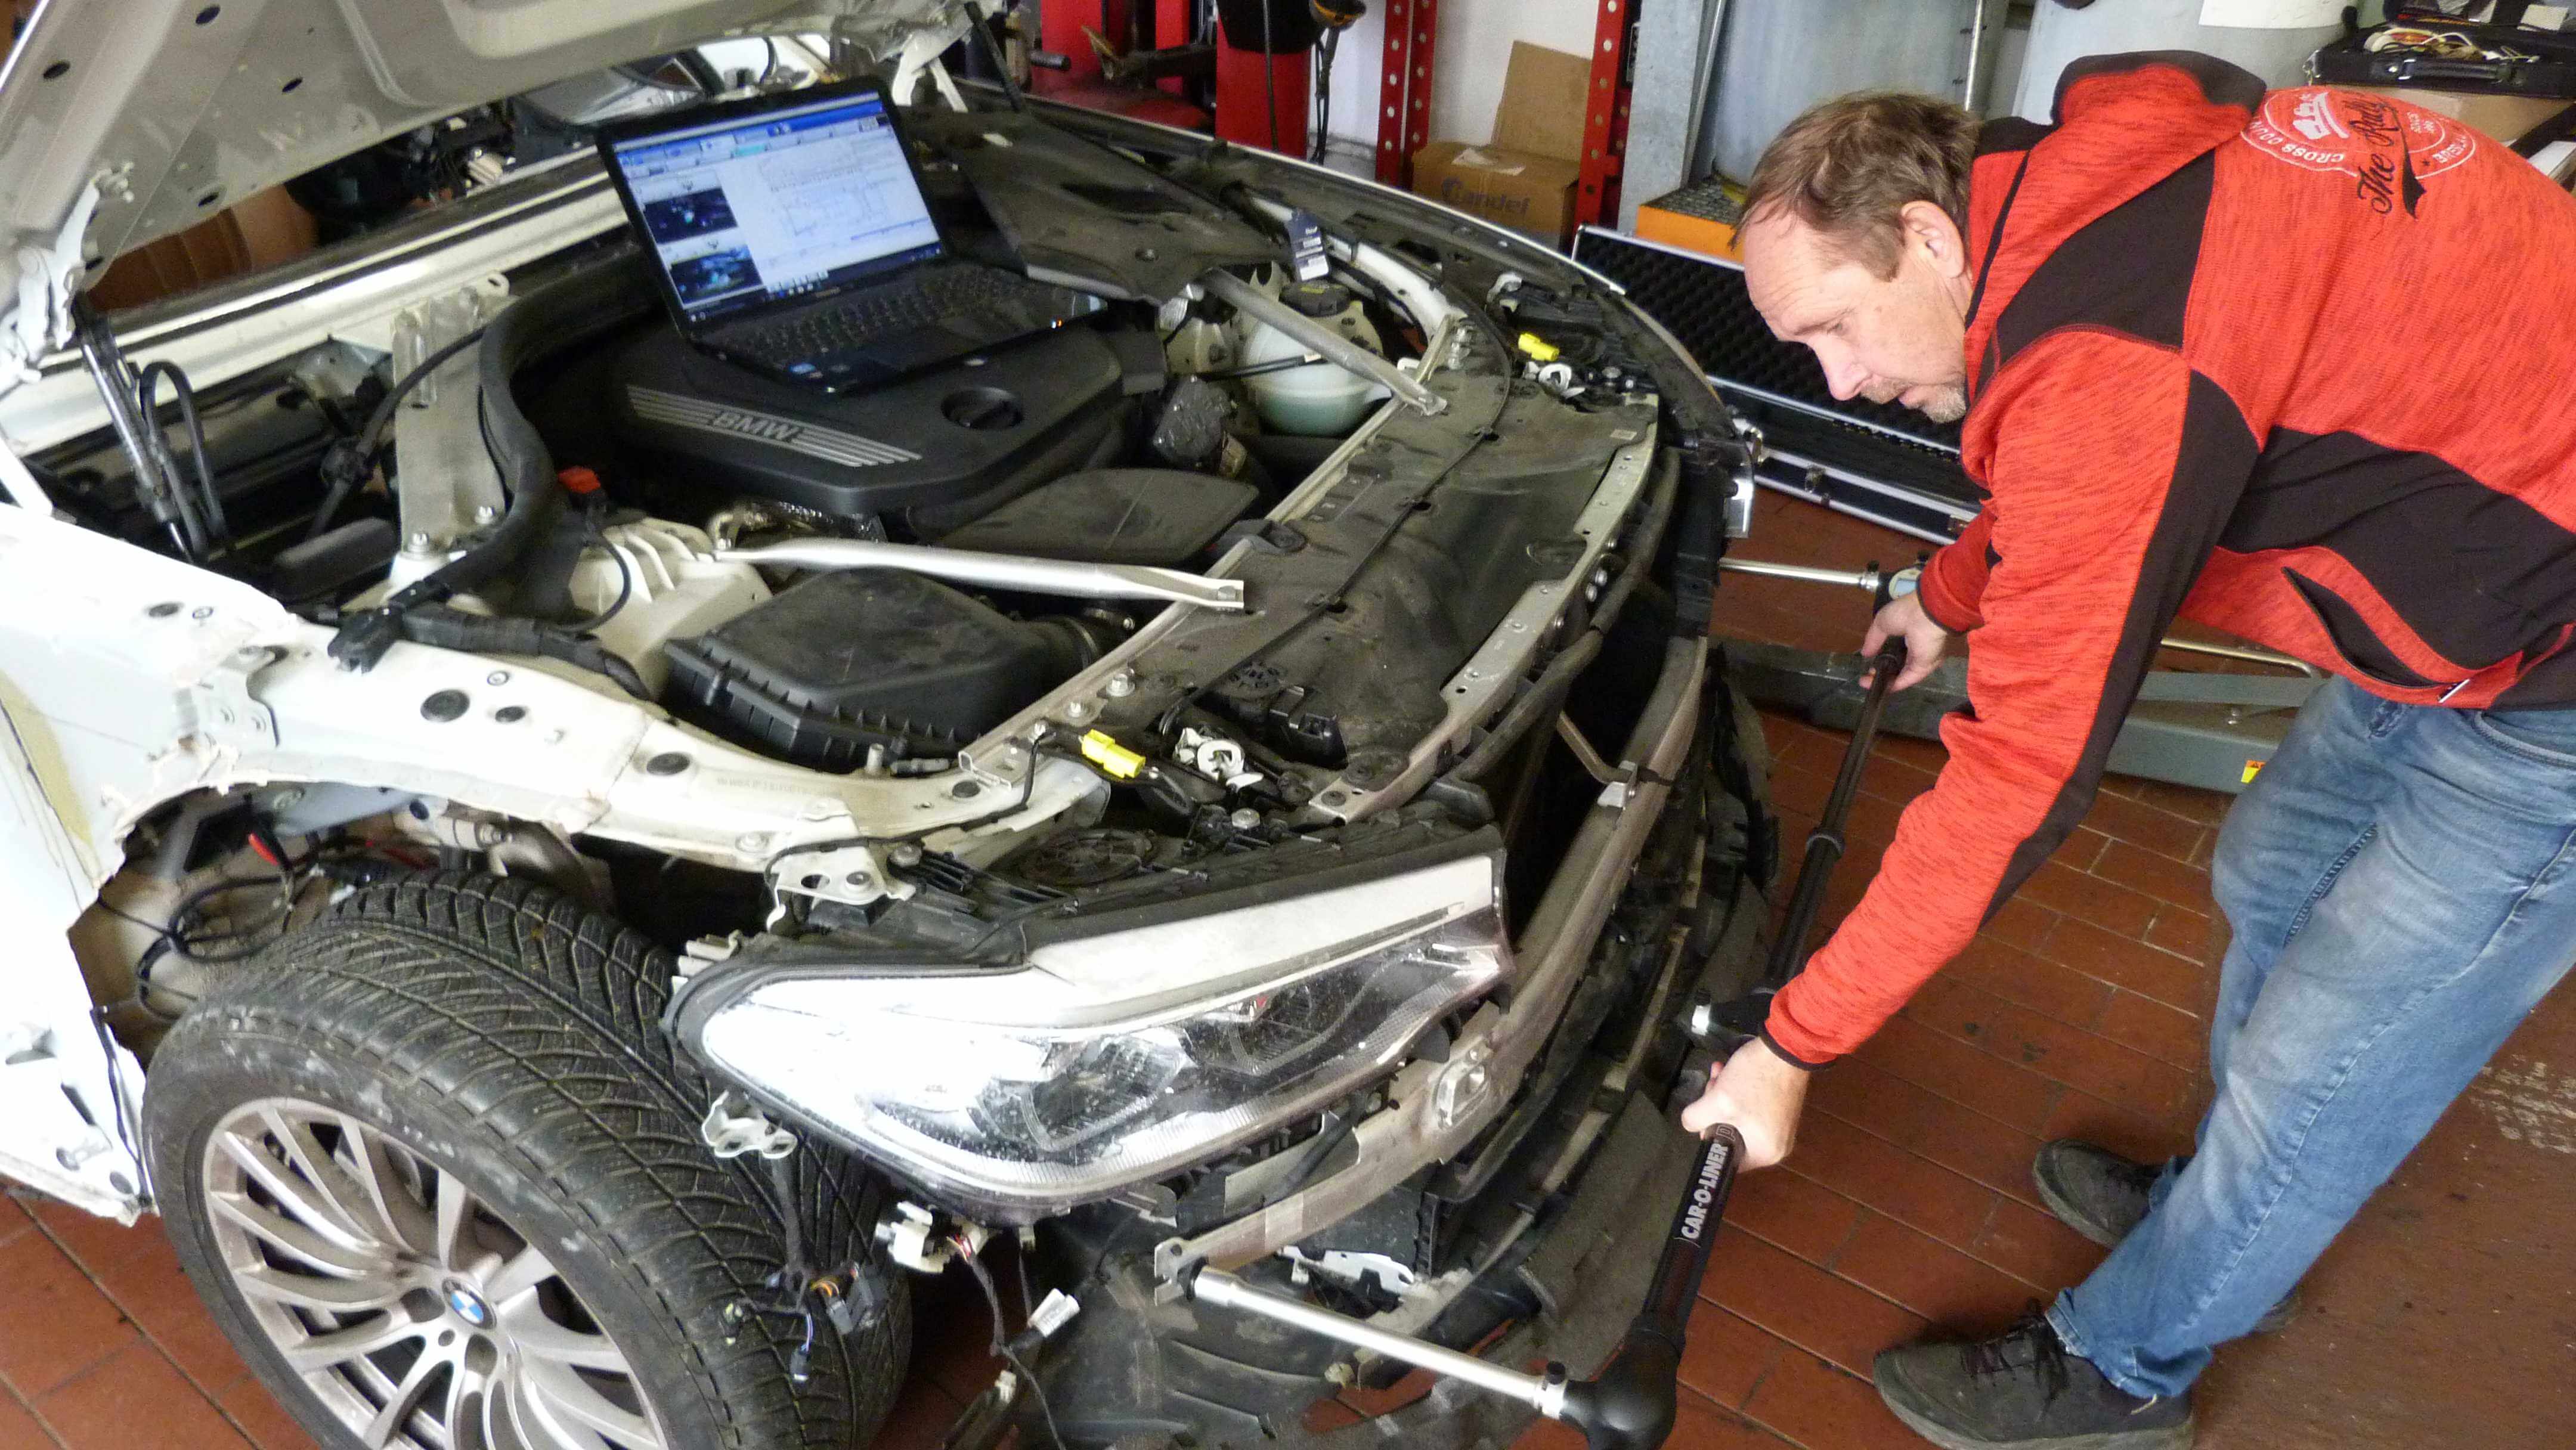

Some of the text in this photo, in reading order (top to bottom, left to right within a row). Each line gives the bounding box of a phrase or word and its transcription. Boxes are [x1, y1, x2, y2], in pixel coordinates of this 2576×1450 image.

[2281, 143, 2345, 163] CROSS
[2357, 153, 2395, 213] The
[713, 411, 801, 439] BMW
[1680, 1142, 1729, 1240] CAR-O-LINER
